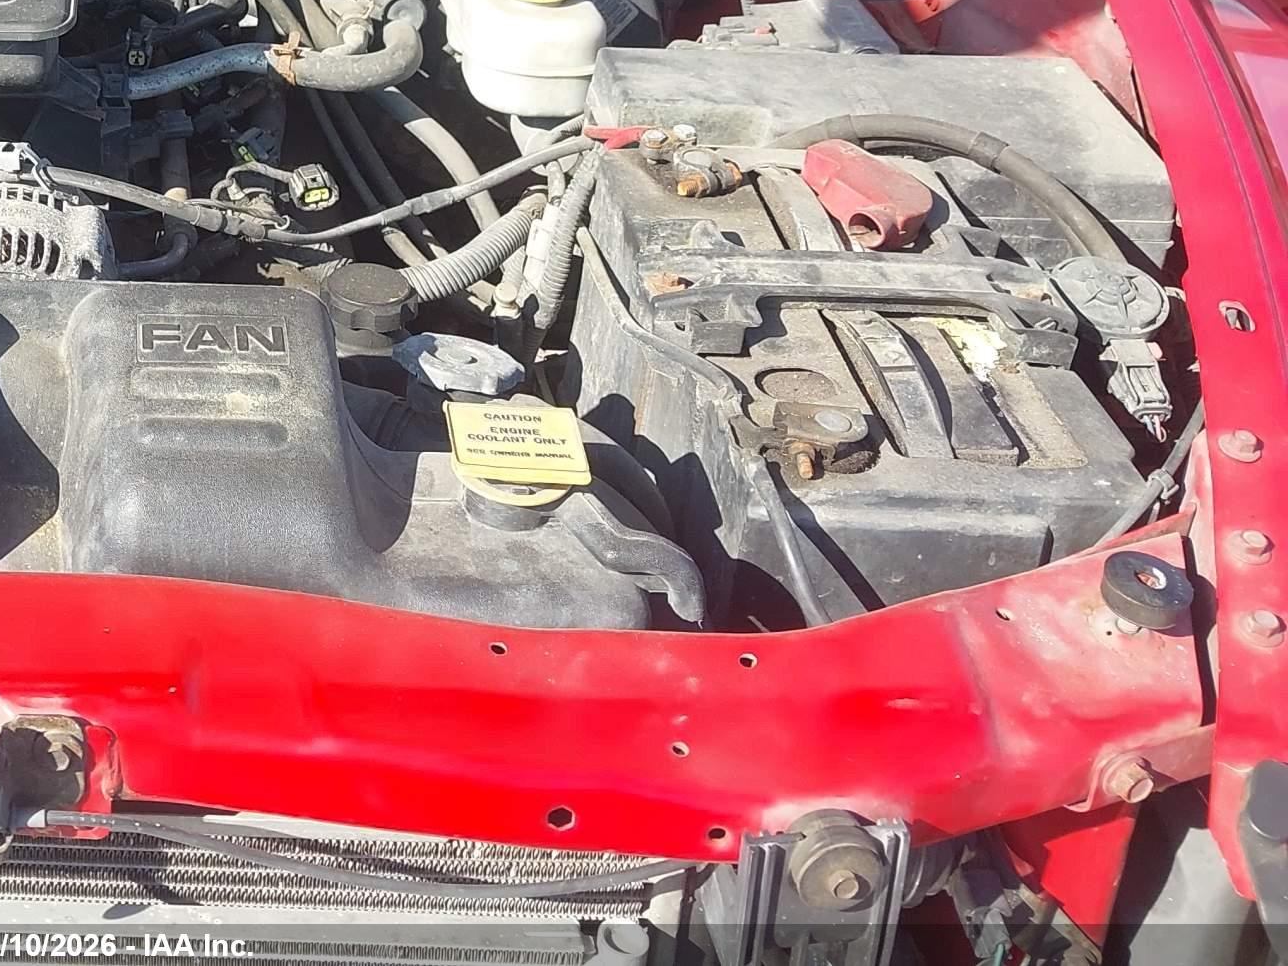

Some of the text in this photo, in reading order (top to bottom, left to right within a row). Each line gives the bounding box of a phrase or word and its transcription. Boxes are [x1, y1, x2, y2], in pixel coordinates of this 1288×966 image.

[141, 323, 287, 355] FAN
[483, 412, 543, 423] CAUTION
[489, 426, 541, 436] ENGINE
[467, 433, 569, 446] COOLANT ONLY
[535, 452, 576, 460] MANUAL
